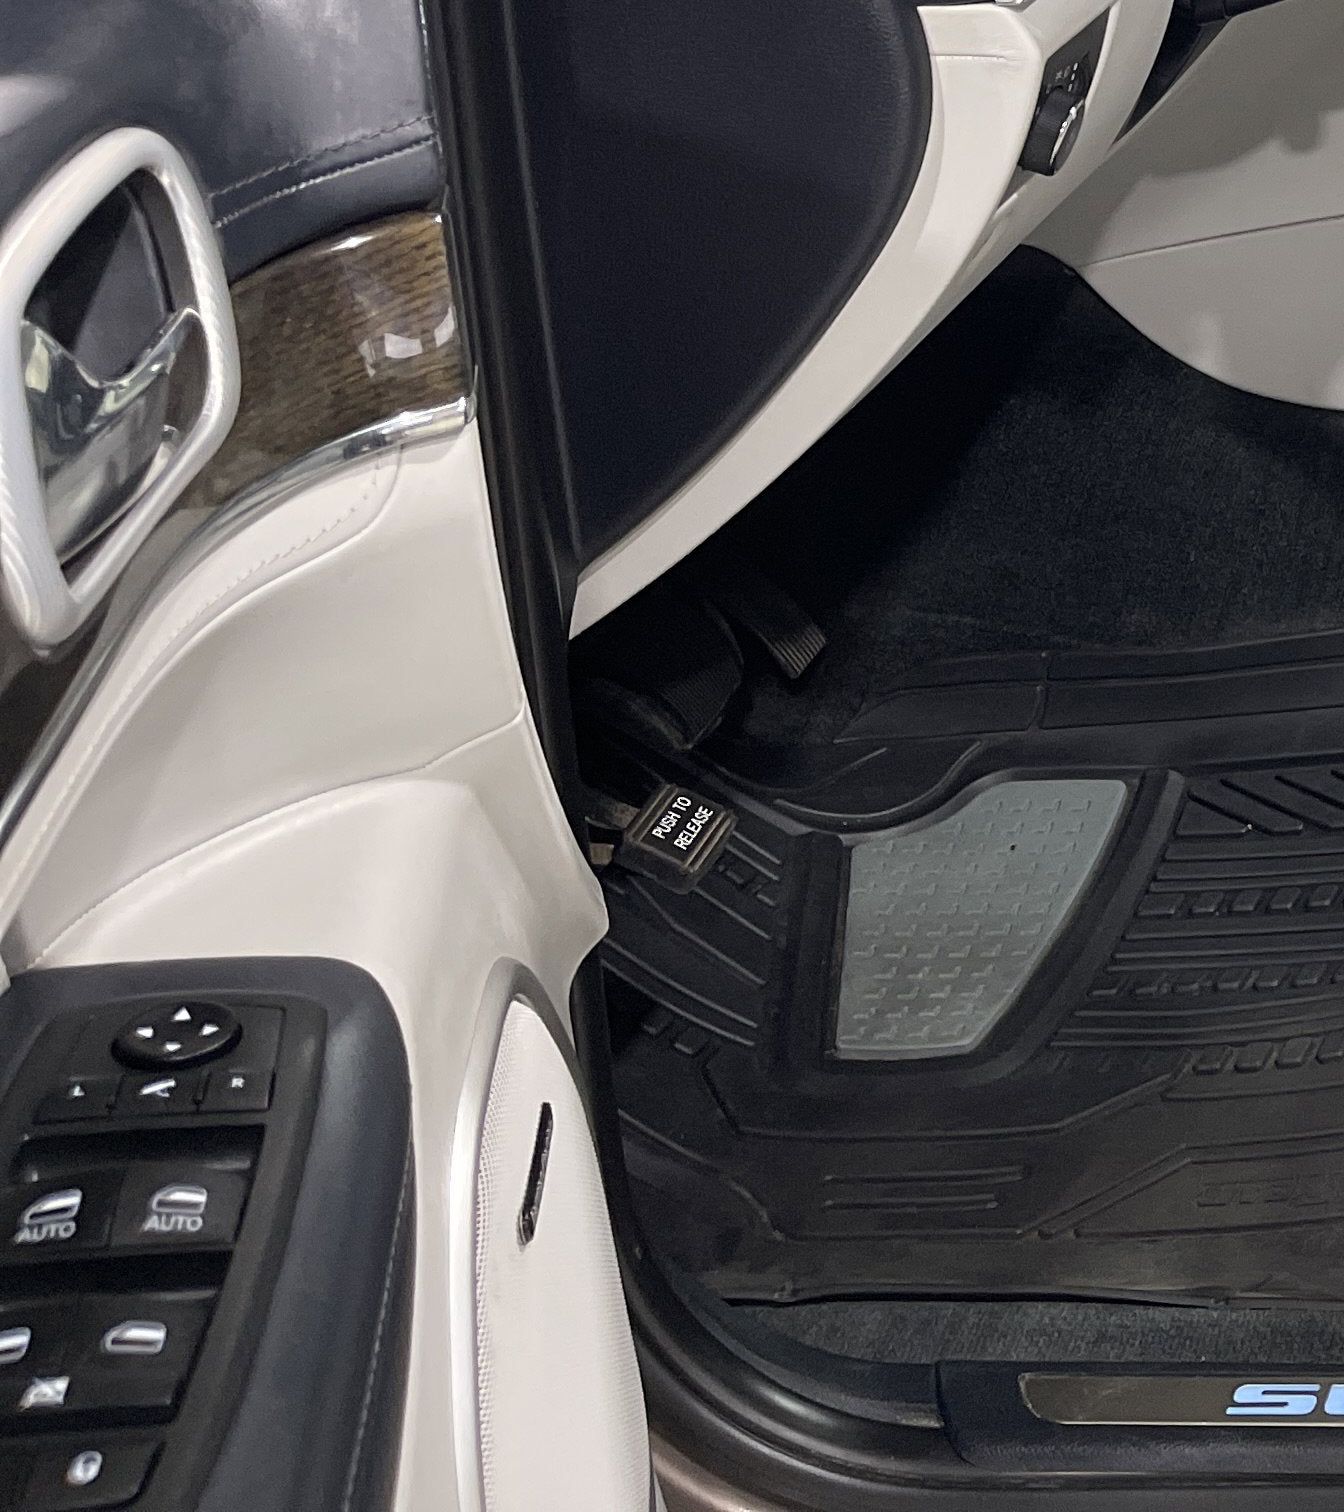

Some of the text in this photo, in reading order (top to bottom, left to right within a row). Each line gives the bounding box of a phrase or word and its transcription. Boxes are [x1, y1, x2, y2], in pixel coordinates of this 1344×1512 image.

[652, 796, 692, 839] PUSH TO
[673, 805, 714, 851] RELEASE
[14, 1220, 76, 1244] AUTO
[142, 1213, 204, 1234] AUTO
